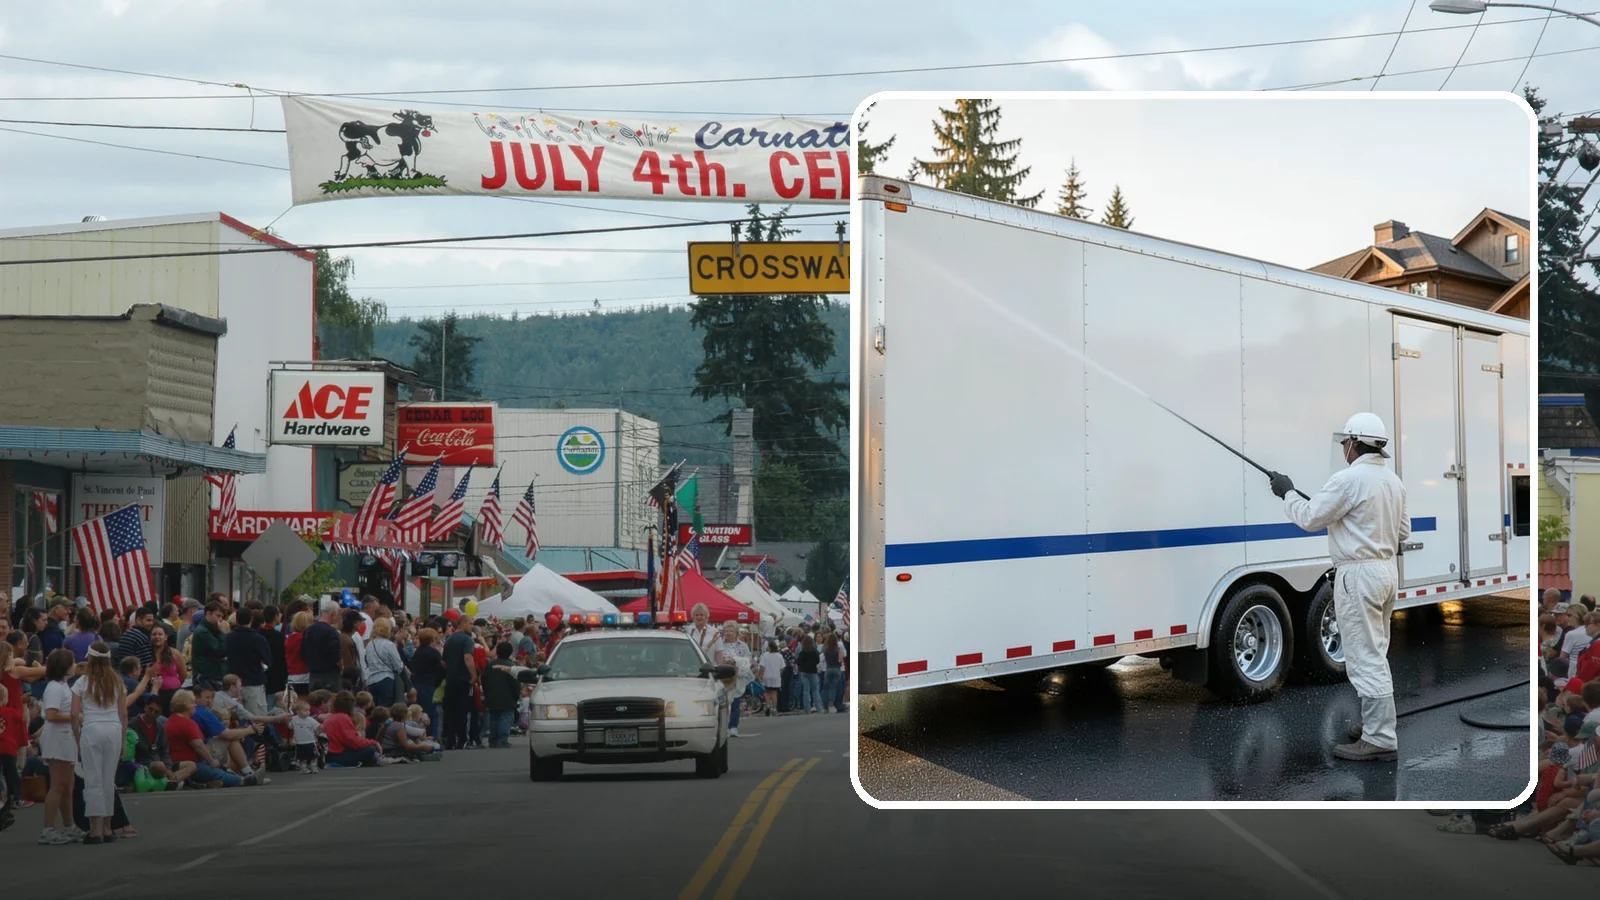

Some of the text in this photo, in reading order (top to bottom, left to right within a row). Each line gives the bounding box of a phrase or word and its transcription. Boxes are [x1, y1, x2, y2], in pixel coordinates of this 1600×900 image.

[481, 140, 604, 192] JULY
[632, 149, 747, 198] 4th.
[697, 253, 851, 280] CROSSWA
[283, 380, 373, 420] ACE
[406, 409, 452, 422] CEDAR
[283, 421, 371, 437] Hardware
[416, 428, 477, 447] Coca-Cola
[353, 467, 384, 480] Simpl
[83, 484, 155, 496] St. Vincent de Paul
[688, 526, 741, 536] CRNATION
[699, 535, 730, 543] GLASS
